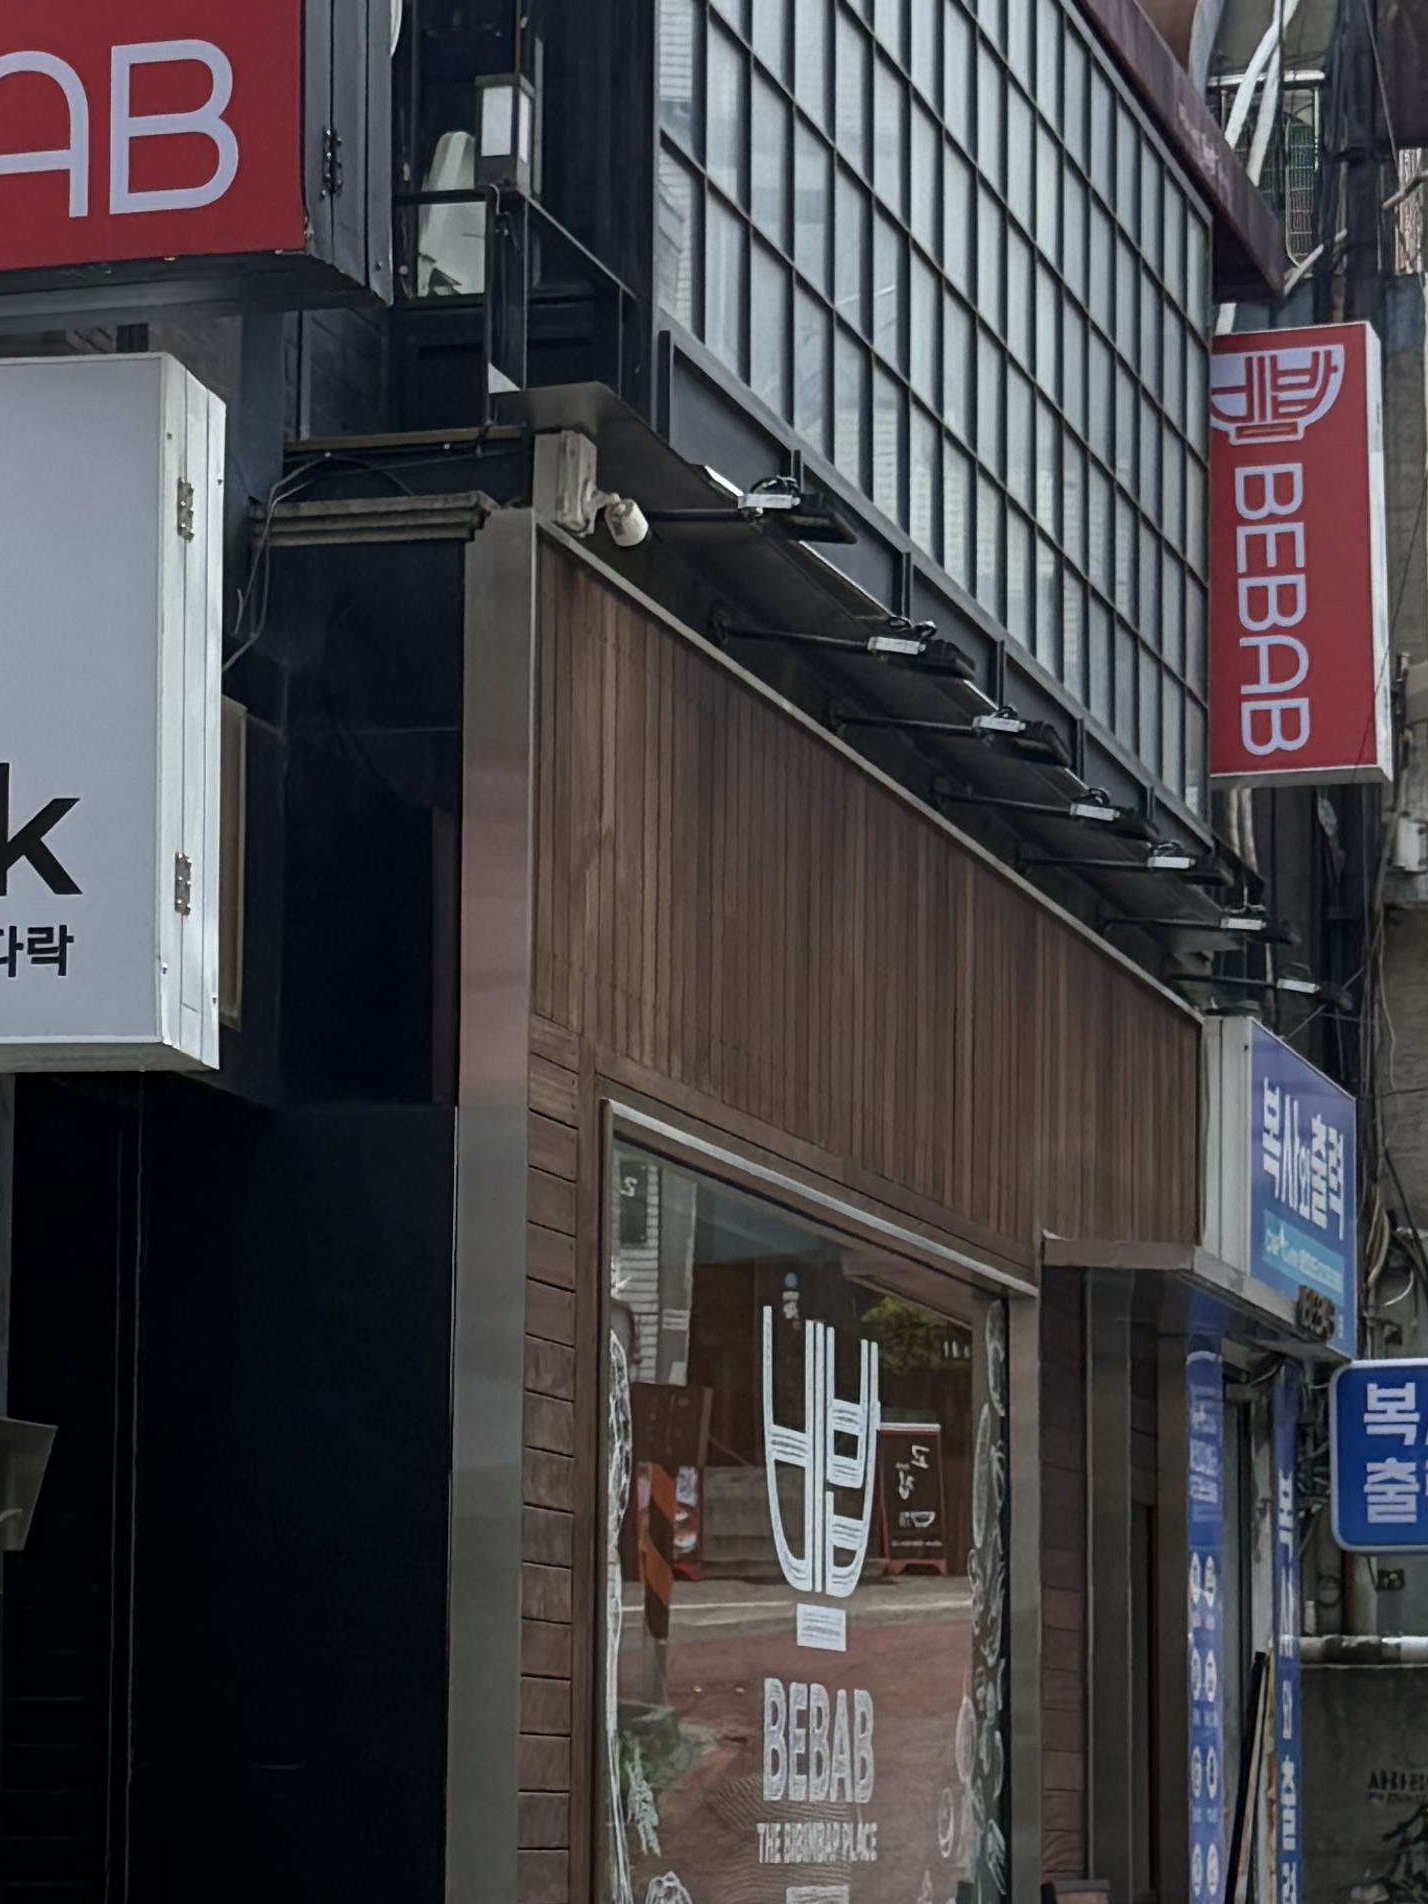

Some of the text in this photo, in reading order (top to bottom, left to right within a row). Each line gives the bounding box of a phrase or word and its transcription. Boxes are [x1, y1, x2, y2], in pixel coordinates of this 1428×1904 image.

[1234, 462, 1311, 758] BEBAB
[762, 1677, 875, 1804] BEBAB
[756, 1822, 782, 1864] THE
